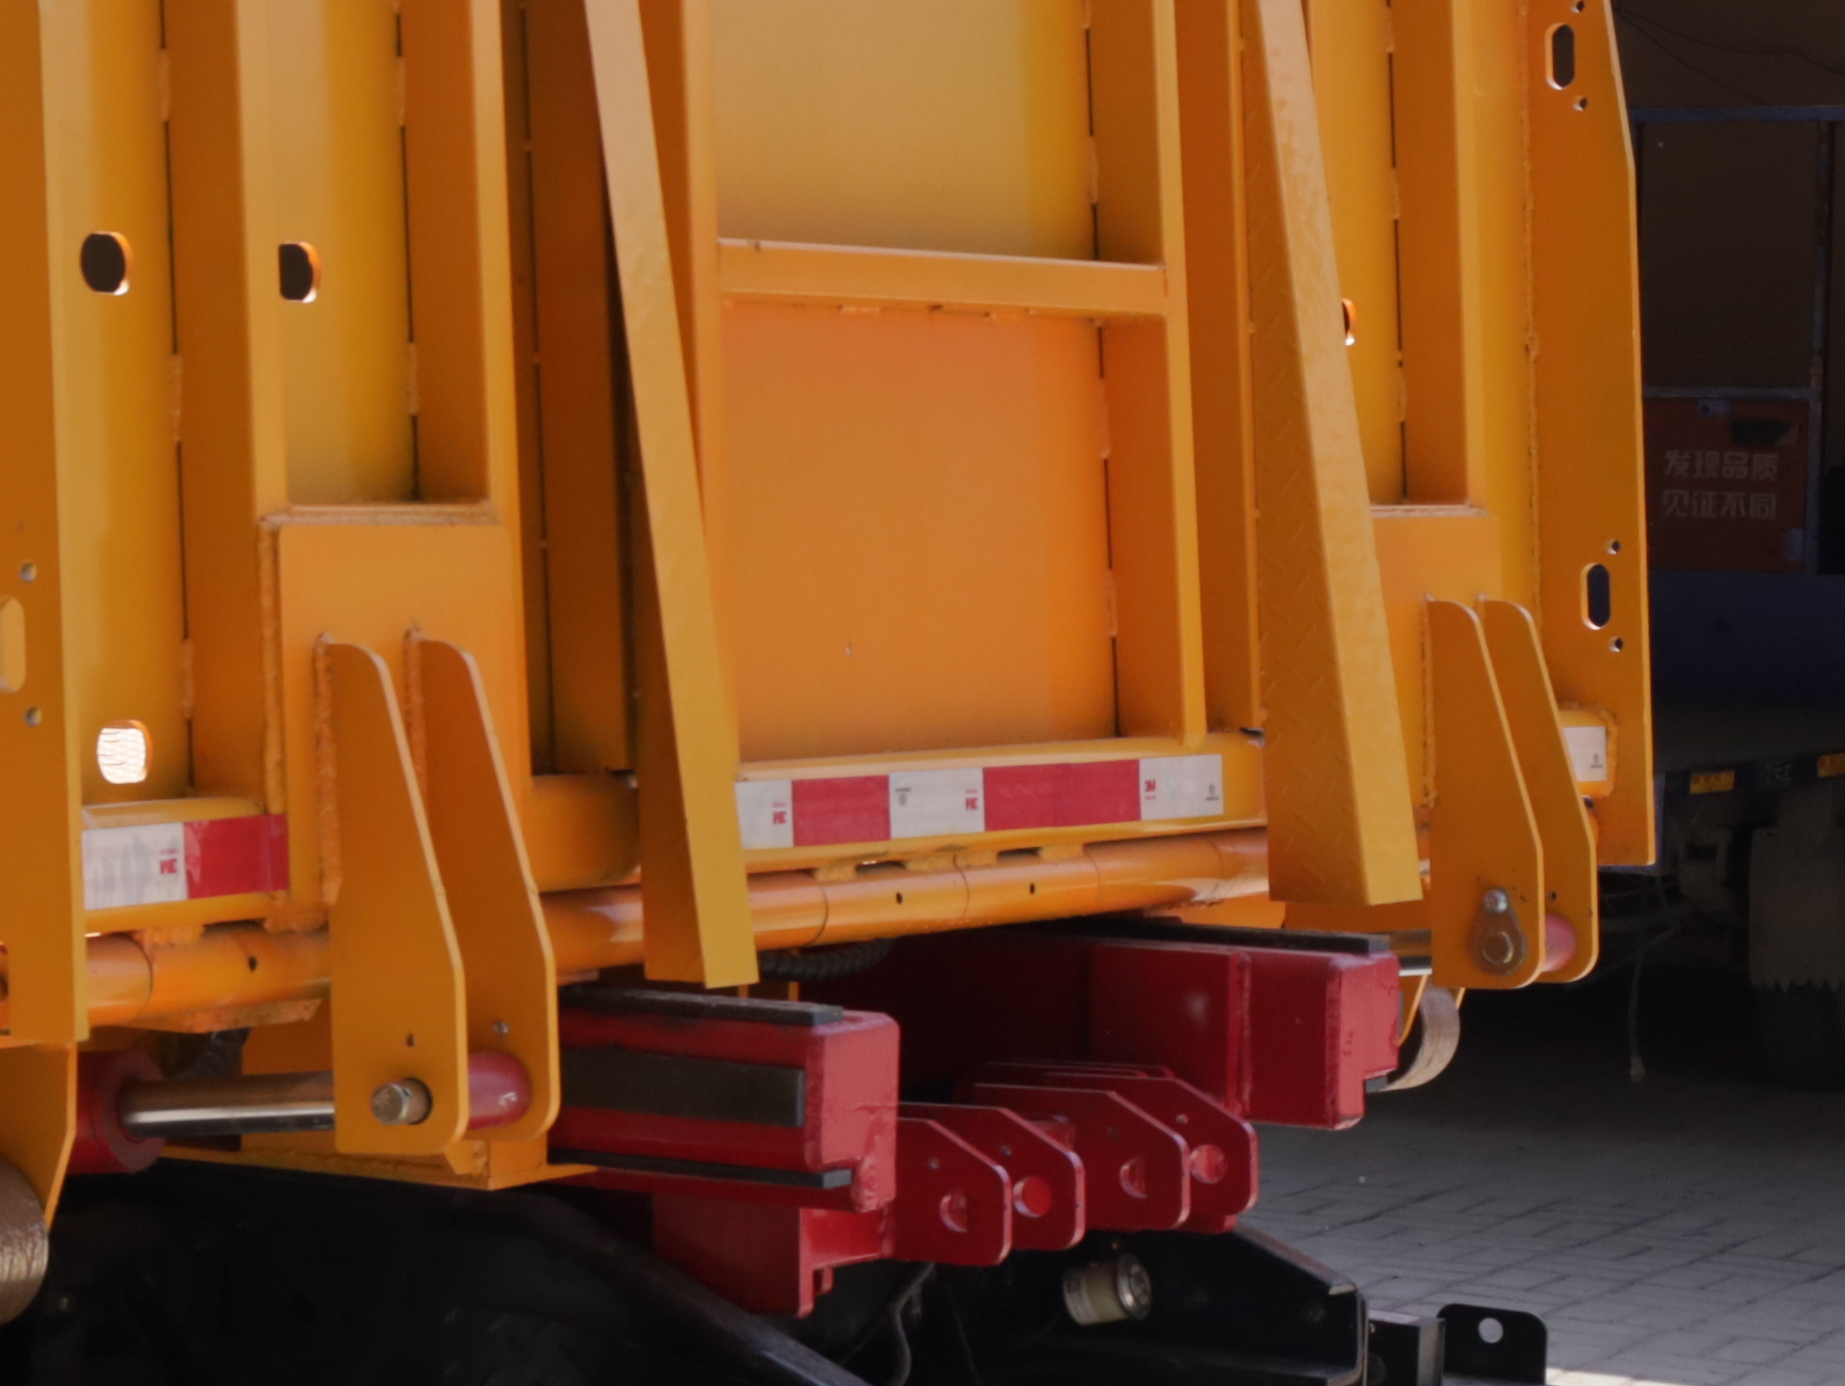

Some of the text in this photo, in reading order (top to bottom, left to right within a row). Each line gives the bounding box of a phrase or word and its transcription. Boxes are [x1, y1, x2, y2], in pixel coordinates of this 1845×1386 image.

[1664, 450, 1780, 481] 发现品质
[1663, 489, 1778, 520] 见证不同
